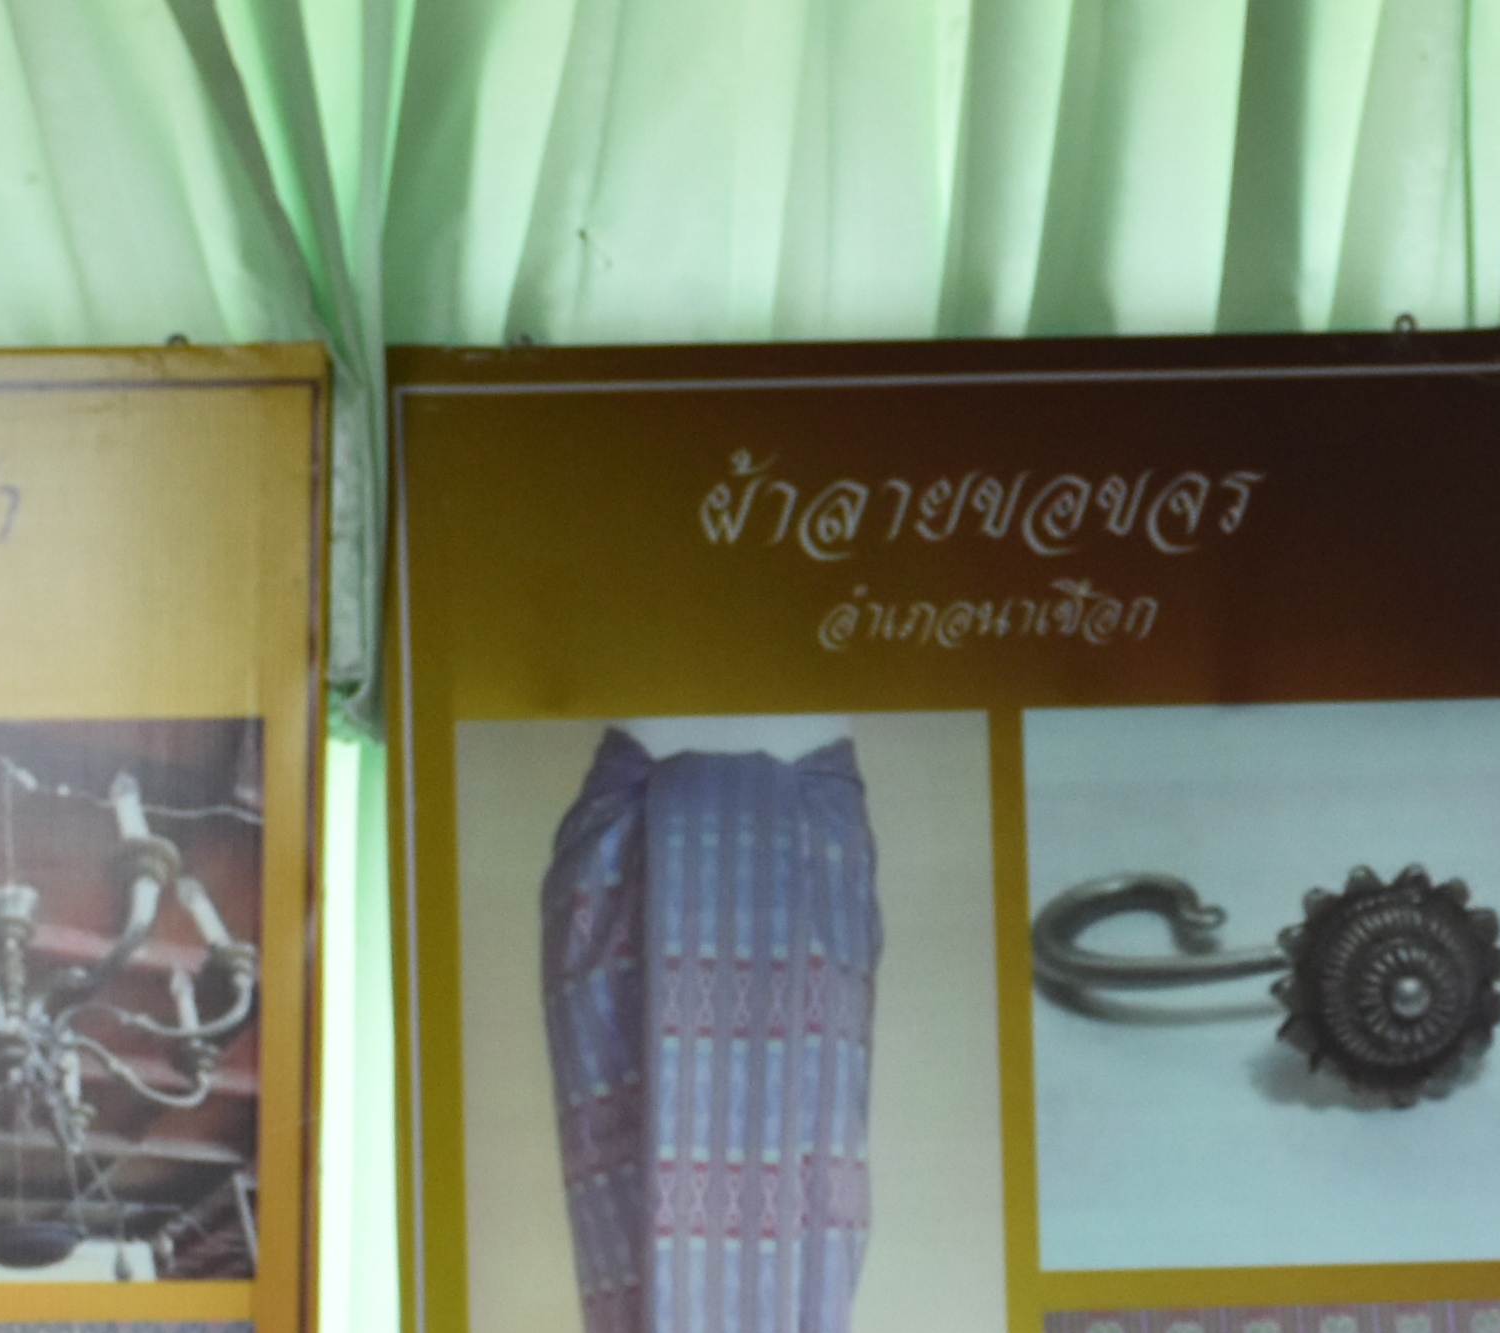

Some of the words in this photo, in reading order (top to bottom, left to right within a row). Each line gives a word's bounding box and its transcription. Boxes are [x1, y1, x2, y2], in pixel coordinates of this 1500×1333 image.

[699, 448, 1266, 562] ผ้าลายขอขจร
[817, 577, 1158, 652] อำเภอนาเชือก
